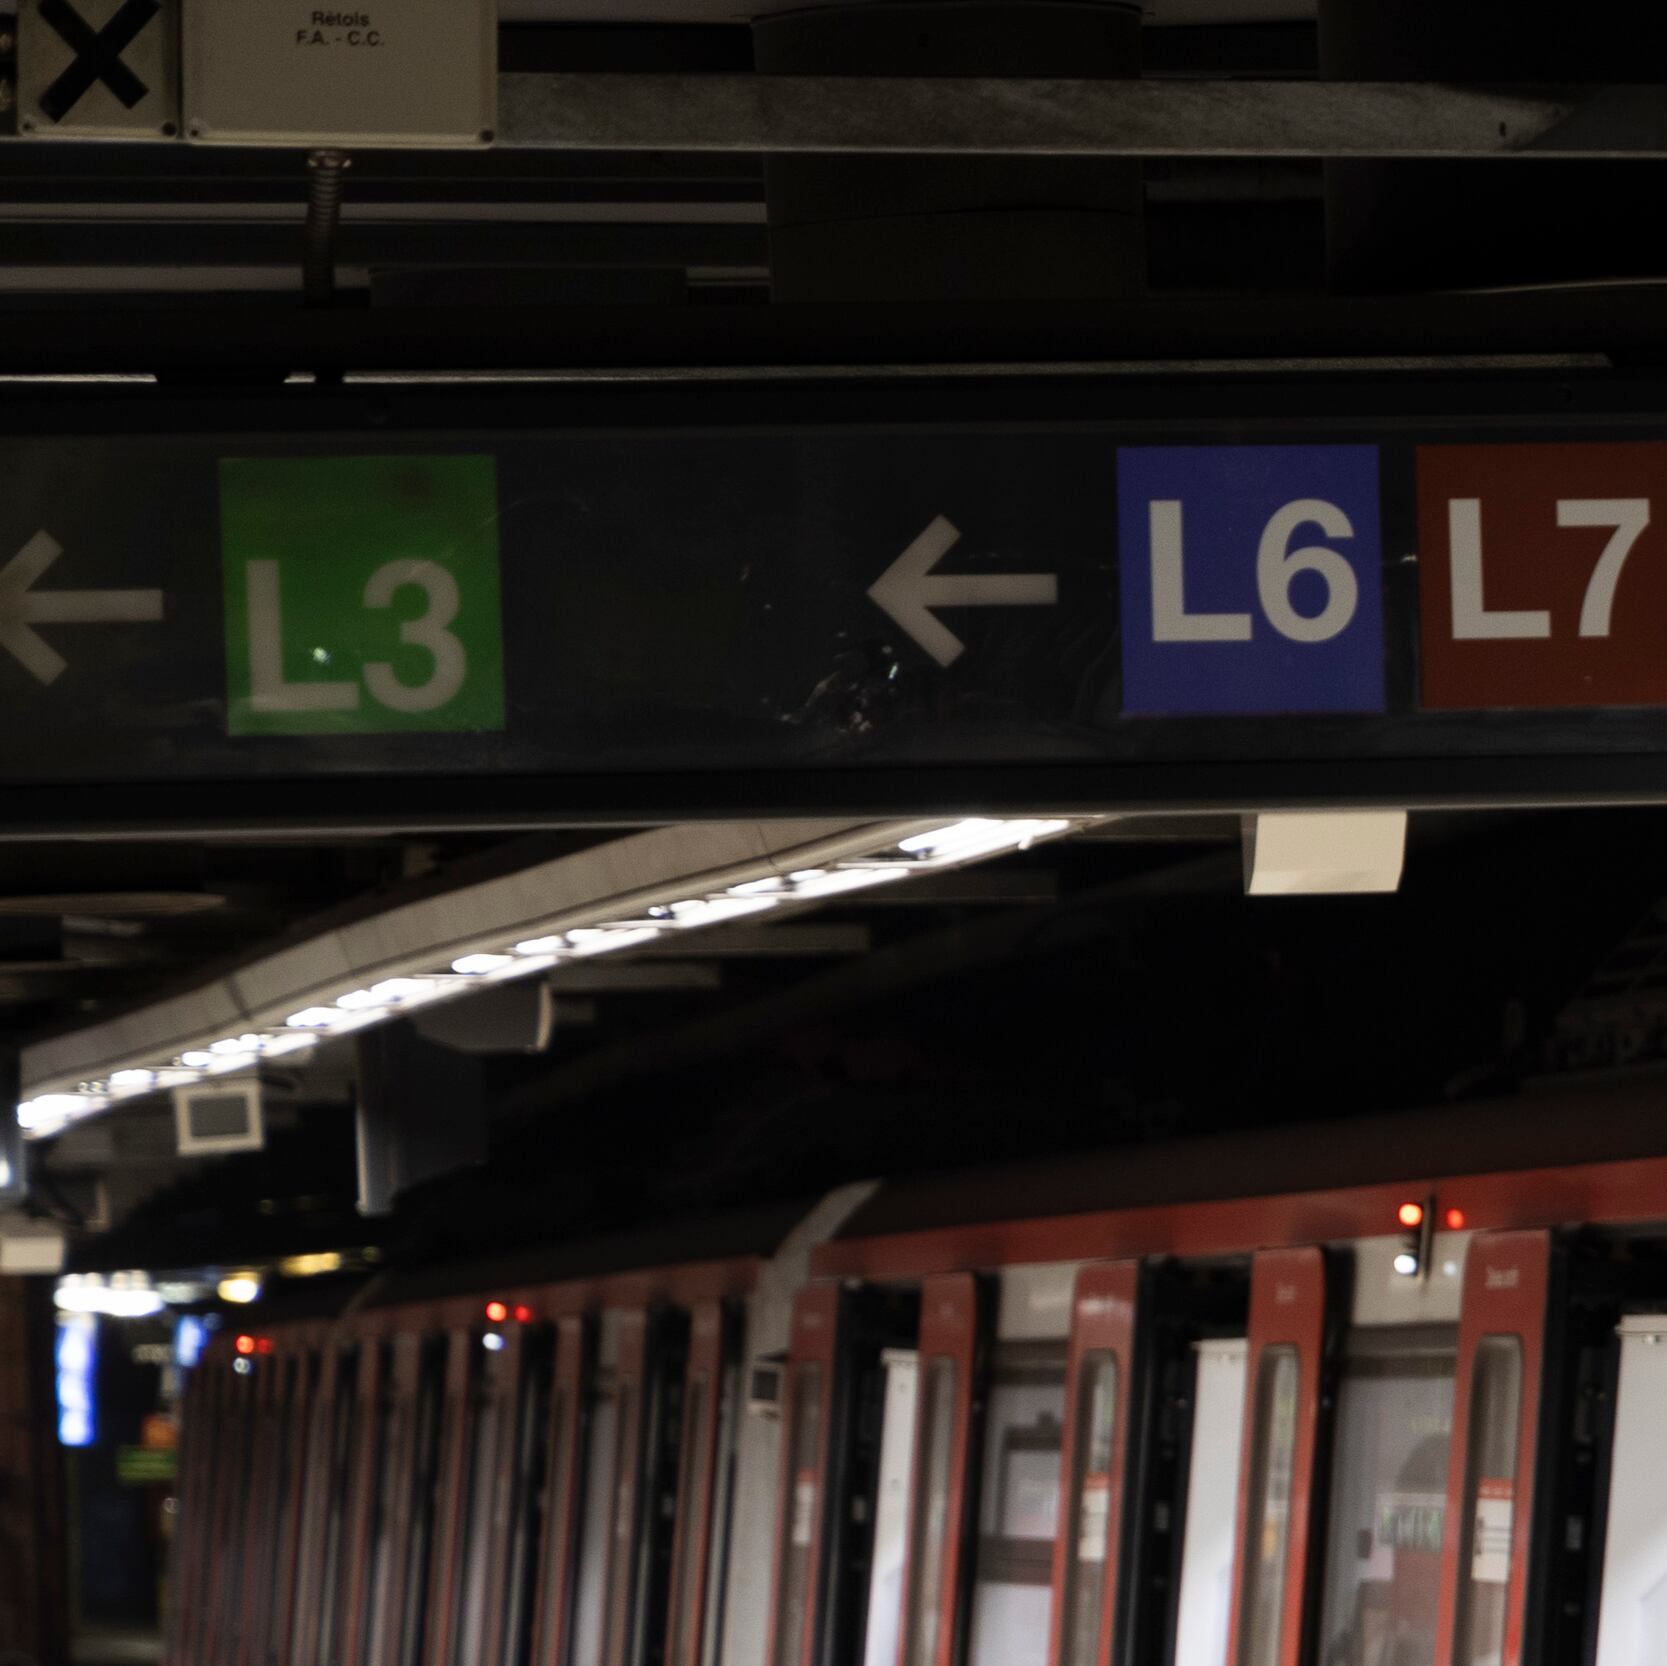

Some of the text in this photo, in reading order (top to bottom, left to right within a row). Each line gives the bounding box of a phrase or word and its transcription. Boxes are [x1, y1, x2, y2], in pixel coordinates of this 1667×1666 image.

[243, 558, 468, 714] L3
[1147, 496, 1653, 644] L6 L7
